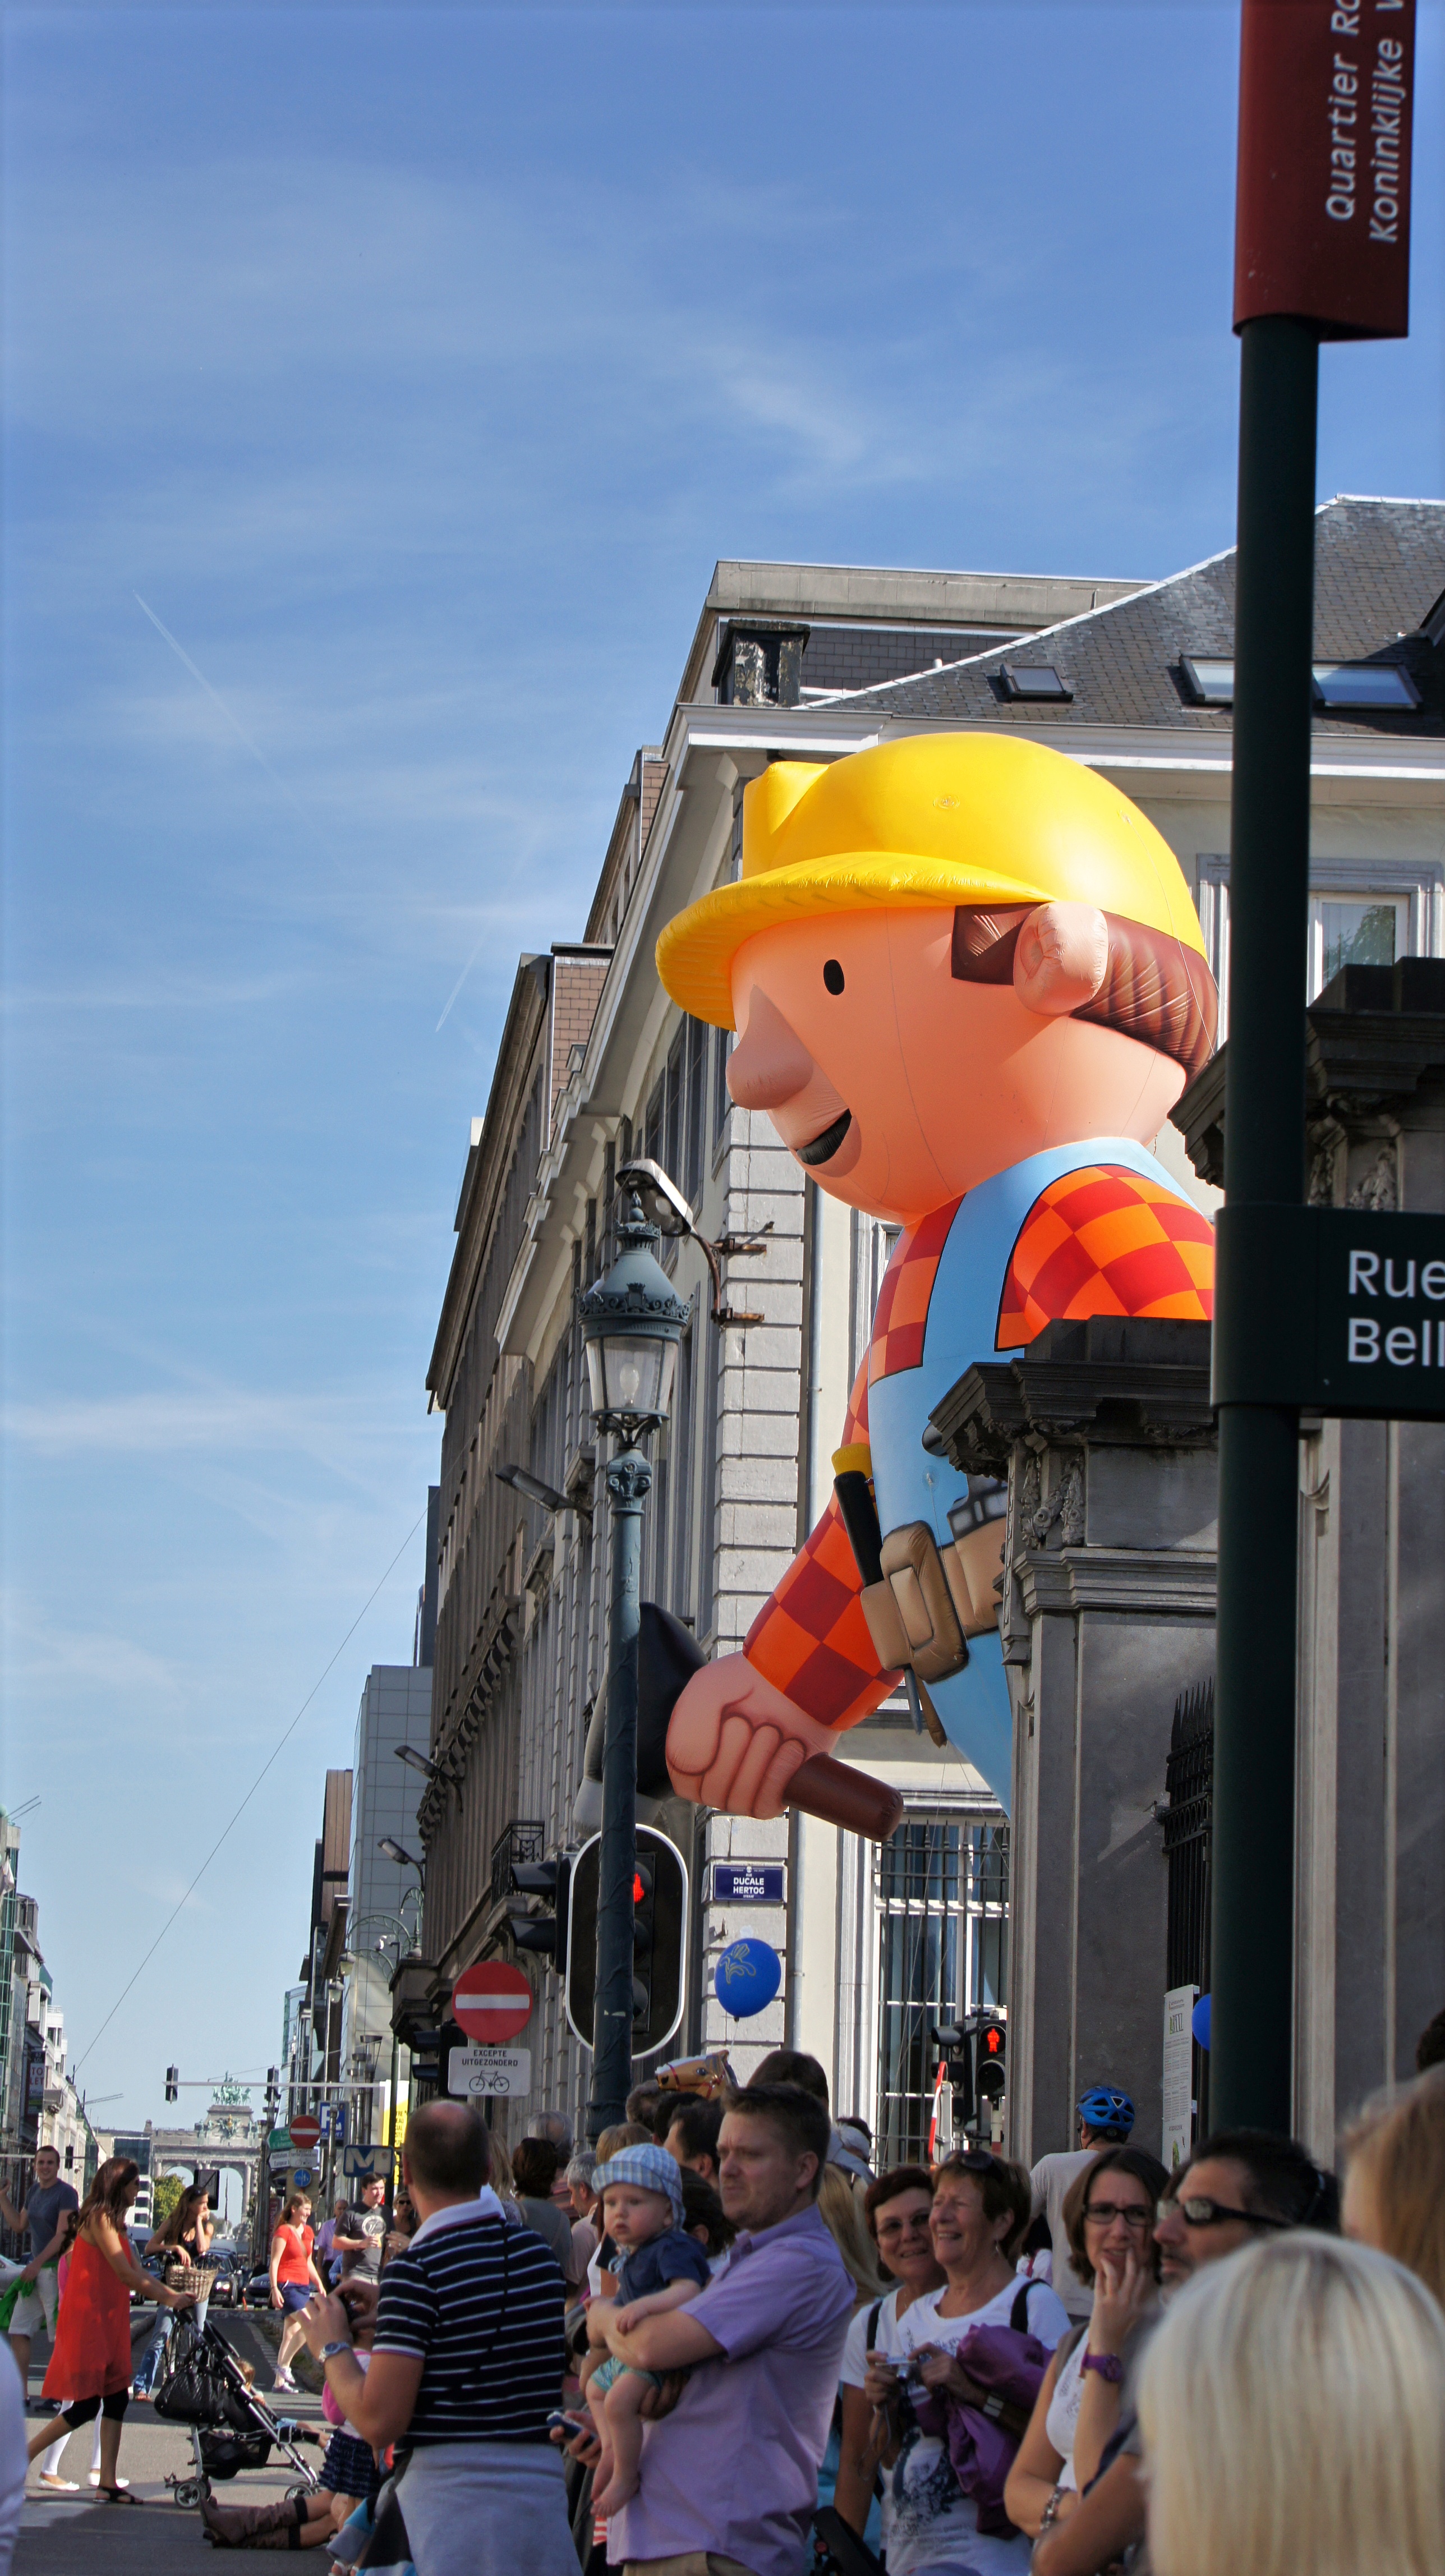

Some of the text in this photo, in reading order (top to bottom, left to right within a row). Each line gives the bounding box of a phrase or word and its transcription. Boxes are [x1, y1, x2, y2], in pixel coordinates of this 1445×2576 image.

[1326, 53, 1359, 220] Quartier
[1369, 39, 1406, 243] Koninklijke
[1349, 1250, 1445, 1300] Rue
[1348, 1318, 1445, 1367] Bell
[733, 1877, 764, 1885] DUCALE
[733, 1886, 765, 1894] HERTOG
[462, 2058, 518, 2067] UITGEZONDERD
[31, 2067, 43, 2076] TO
[30, 2077, 44, 2085] LET
